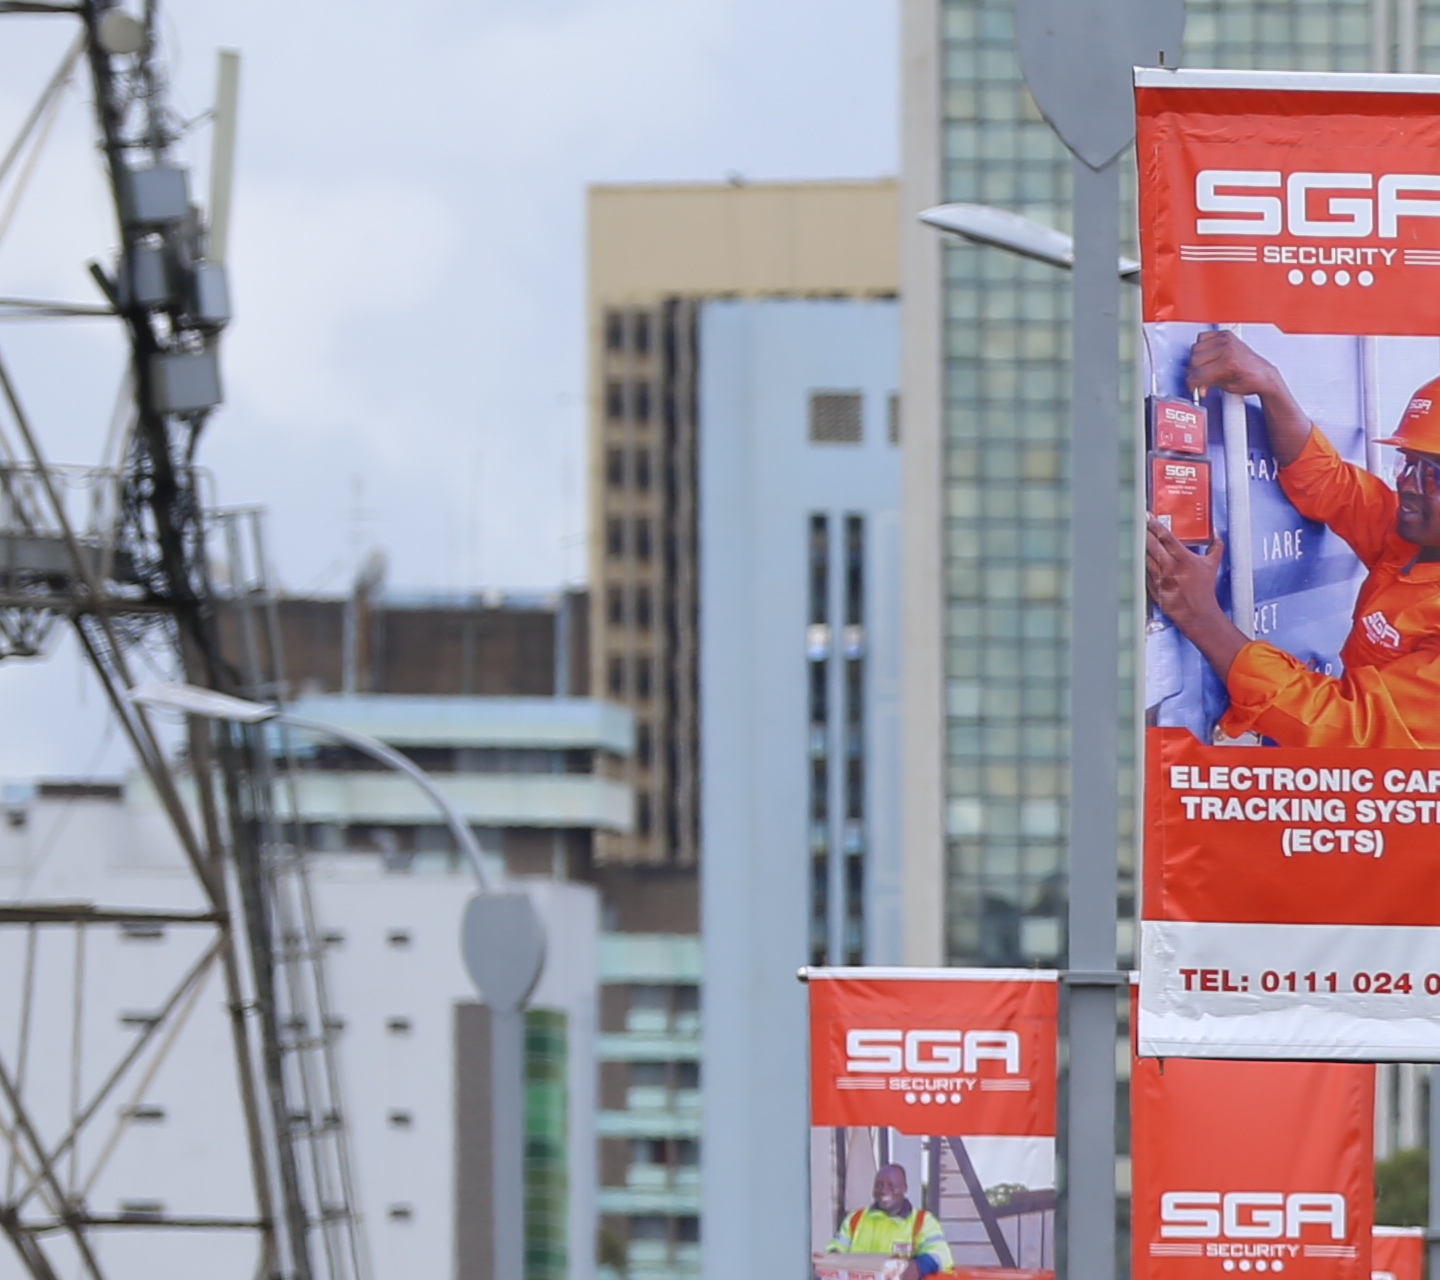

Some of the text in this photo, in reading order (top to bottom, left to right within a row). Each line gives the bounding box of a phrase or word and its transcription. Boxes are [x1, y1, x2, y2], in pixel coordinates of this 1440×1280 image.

[1262, 245, 1398, 267] SECURITY
[1164, 407, 1197, 424] SGA
[1165, 465, 1196, 478] SGA
[1170, 765, 1375, 793] ELECTRONIC
[1181, 796, 1346, 823] TRACKING
[1281, 828, 1384, 858] (ECTS)
[1179, 968, 1250, 992] TEL:
[1261, 970, 1338, 993] 0111
[1353, 972, 1413, 995] 024
[846, 1029, 1020, 1074] SGA
[889, 1077, 977, 1092] SECURITY
[1160, 1191, 1346, 1240] SGA
[1206, 1243, 1300, 1259] SECURITY
